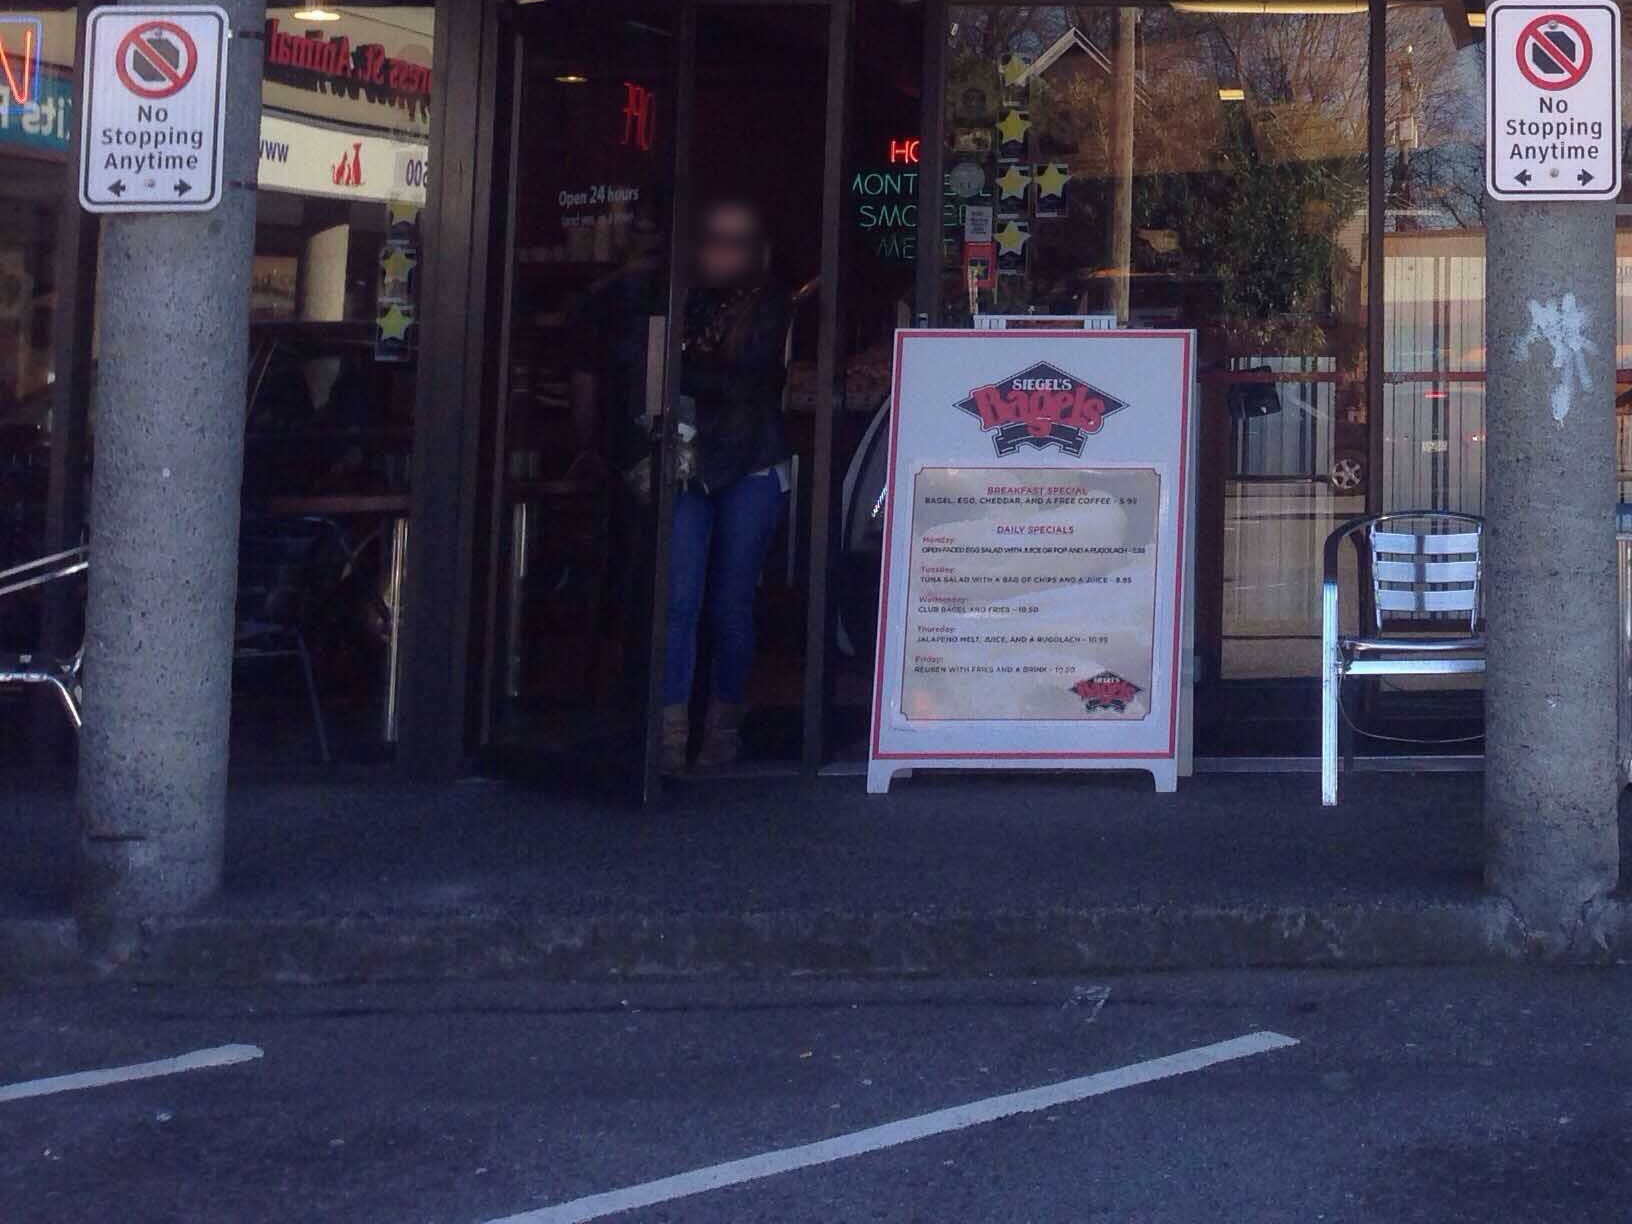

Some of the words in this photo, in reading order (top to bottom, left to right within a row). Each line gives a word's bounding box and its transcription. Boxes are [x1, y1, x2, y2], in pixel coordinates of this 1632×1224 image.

[138, 105, 169, 123] No
[1539, 97, 1569, 114] No
[101, 127, 203, 149] Stopping
[1506, 117, 1603, 140] Stopping
[104, 151, 199, 174] Anytime
[1509, 141, 1600, 164] Anytime
[559, 190, 587, 209] Open
[589, 185, 605, 204] 24
[607, 185, 640, 202] hours
[1011, 378, 1073, 391] SIEGEL'S
[970, 385, 1106, 439] Bagels
[996, 525, 1026, 535] DAILY
[1027, 525, 1074, 535] SPECIALS
